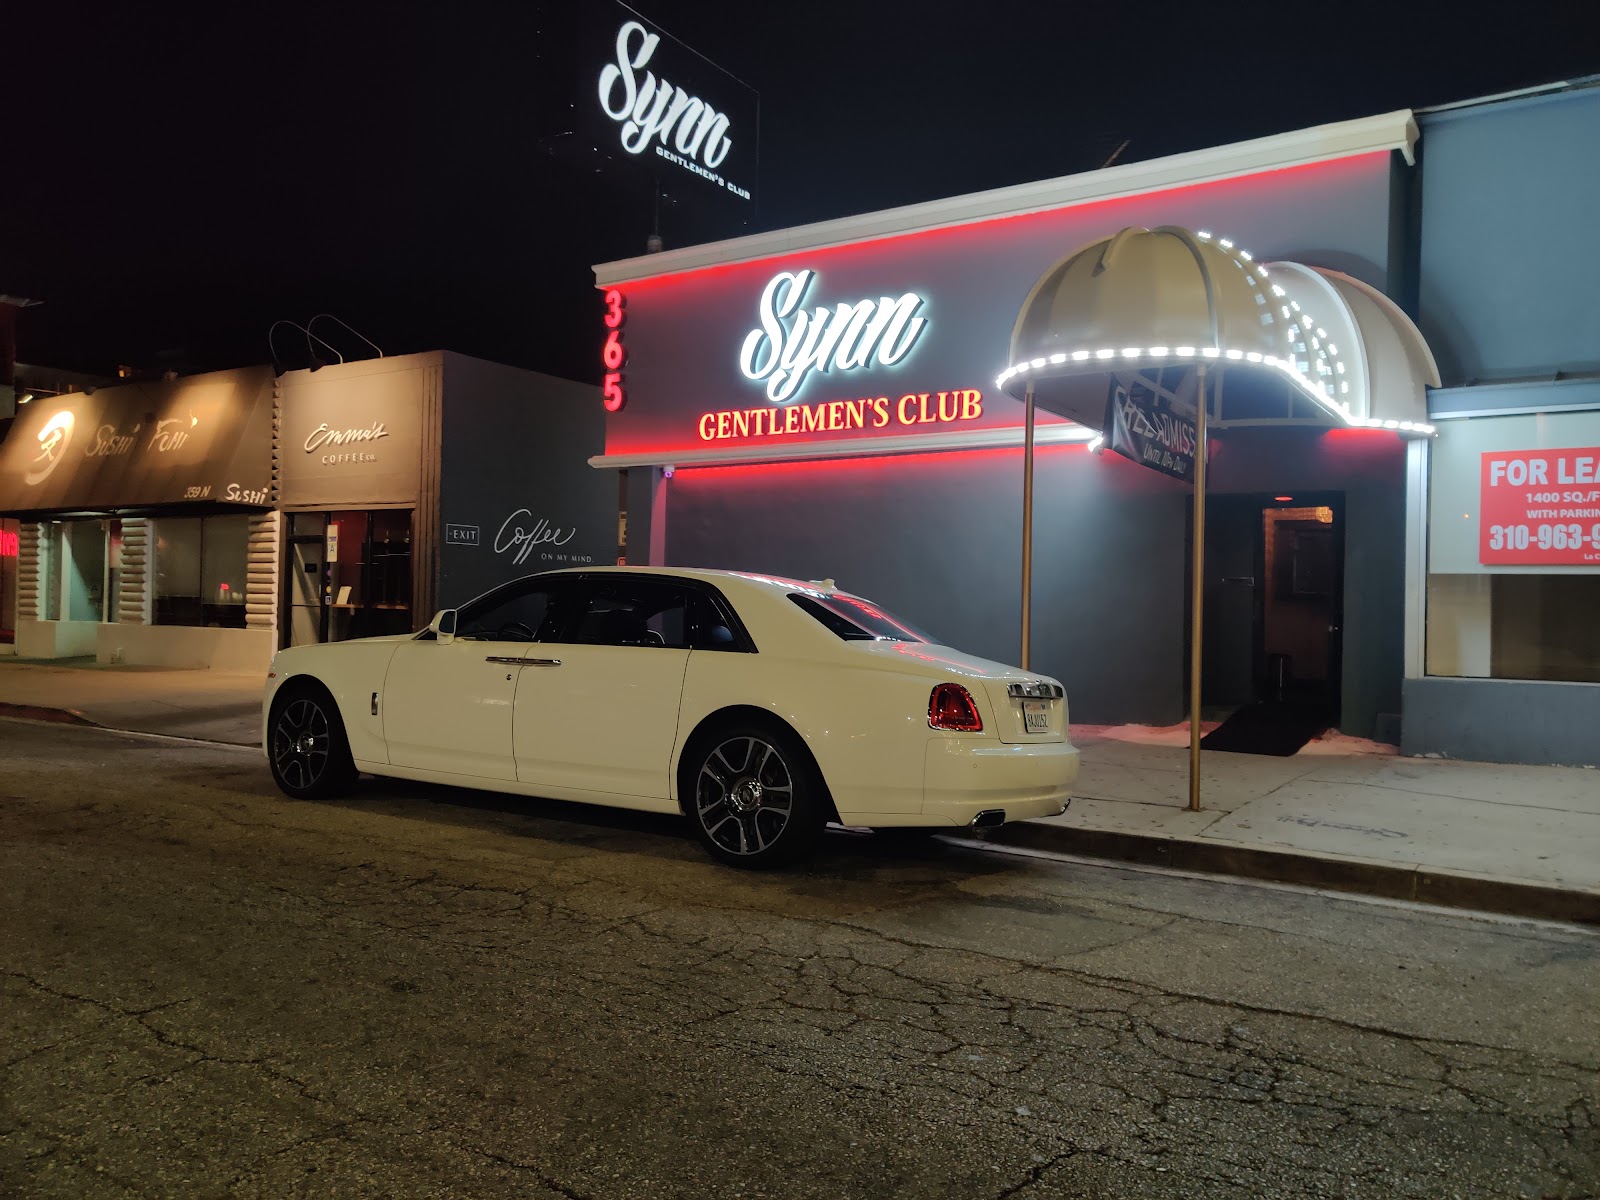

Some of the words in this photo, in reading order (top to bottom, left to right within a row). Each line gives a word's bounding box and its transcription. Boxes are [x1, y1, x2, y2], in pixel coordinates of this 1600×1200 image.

[598, 21, 732, 169] Synn
[655, 145, 725, 187] GENTLEMEN'S
[727, 181, 750, 201] CLUB
[603, 289, 625, 412] 365
[739, 270, 928, 402] Synn
[698, 397, 890, 441] GENTLEMEN'S
[897, 389, 983, 426] CLUB
[304, 421, 388, 452] Emma's
[322, 453, 364, 464] COFFEE
[1143, 443, 1161, 465] UNTIL
[1490, 458, 1548, 487] FOR
[184, 486, 201, 499] 359
[200, 485, 211, 498] N
[1526, 492, 1560, 503] 1400
[1526, 509, 1558, 519] WITH
[453, 529, 477, 541] EXIT
[494, 508, 576, 565] Coffee
[541, 552, 553, 561] ON
[556, 554, 568, 562] MY
